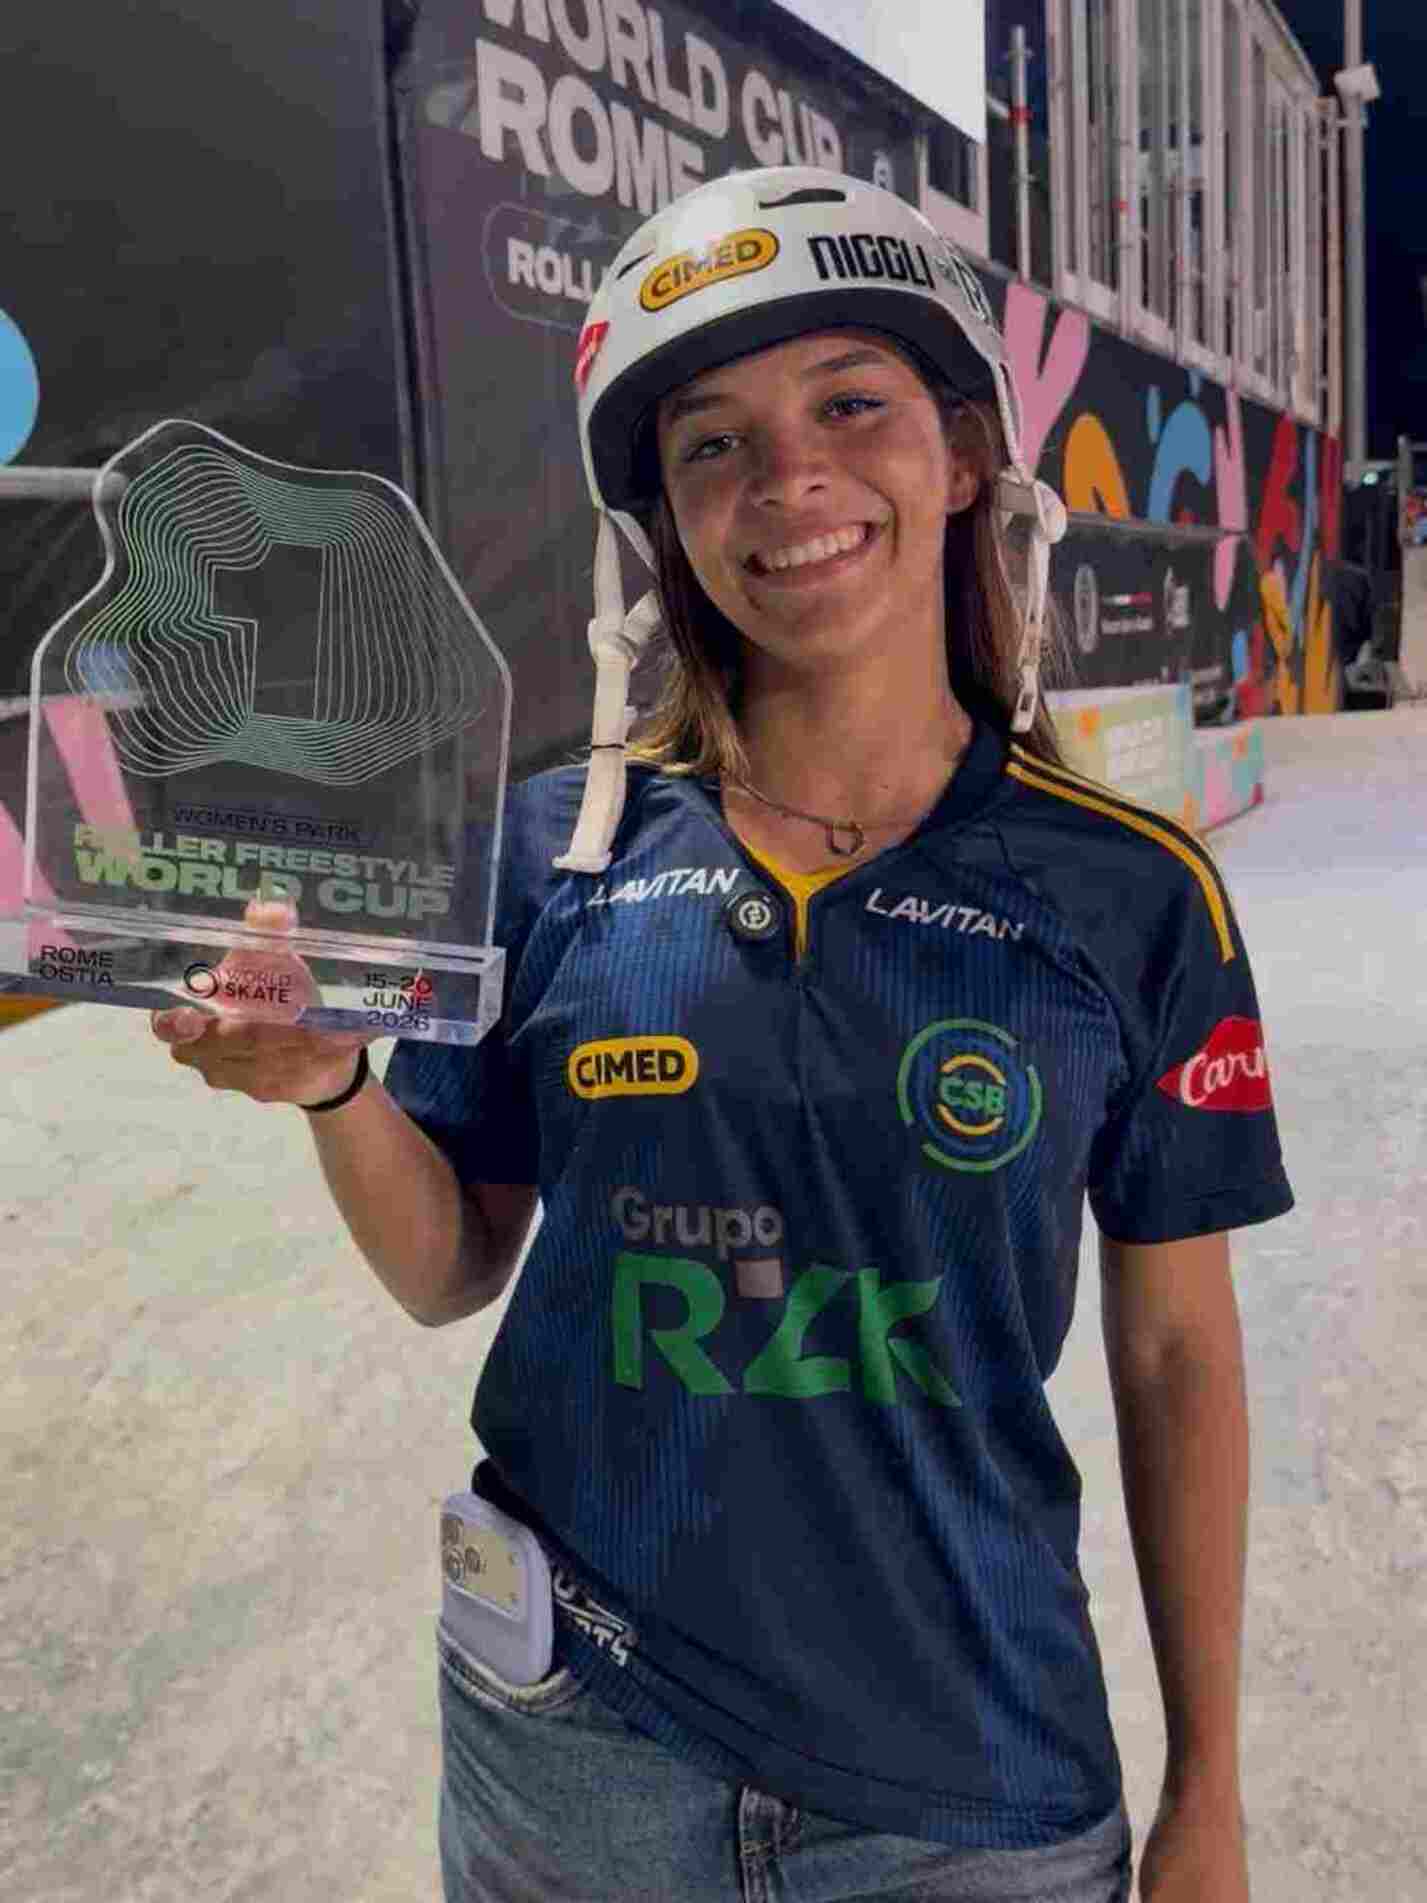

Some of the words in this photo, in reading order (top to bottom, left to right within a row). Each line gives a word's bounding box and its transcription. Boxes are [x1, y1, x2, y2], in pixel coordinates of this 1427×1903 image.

[475, 37, 706, 217] ROME
[742, 69, 843, 173] CUP
[507, 237, 608, 305] ROLL
[651, 240, 761, 297] CIMED
[74, 823, 227, 865] RLLER
[234, 841, 455, 887] FREESTYLE
[74, 849, 302, 901] WORLD
[317, 877, 449, 921] CUP
[586, 868, 741, 907] LAVITAN
[864, 887, 1025, 941] LAVITAN
[39, 964, 114, 985] OSTIA
[40, 945, 113, 968] ROME
[225, 982, 289, 1003] SKATE
[363, 992, 431, 1013] JUNE
[365, 972, 432, 994] 15-20
[367, 1010, 430, 1032] 2026
[575, 1049, 686, 1088] CIMED
[610, 1185, 784, 1261] Grupo
